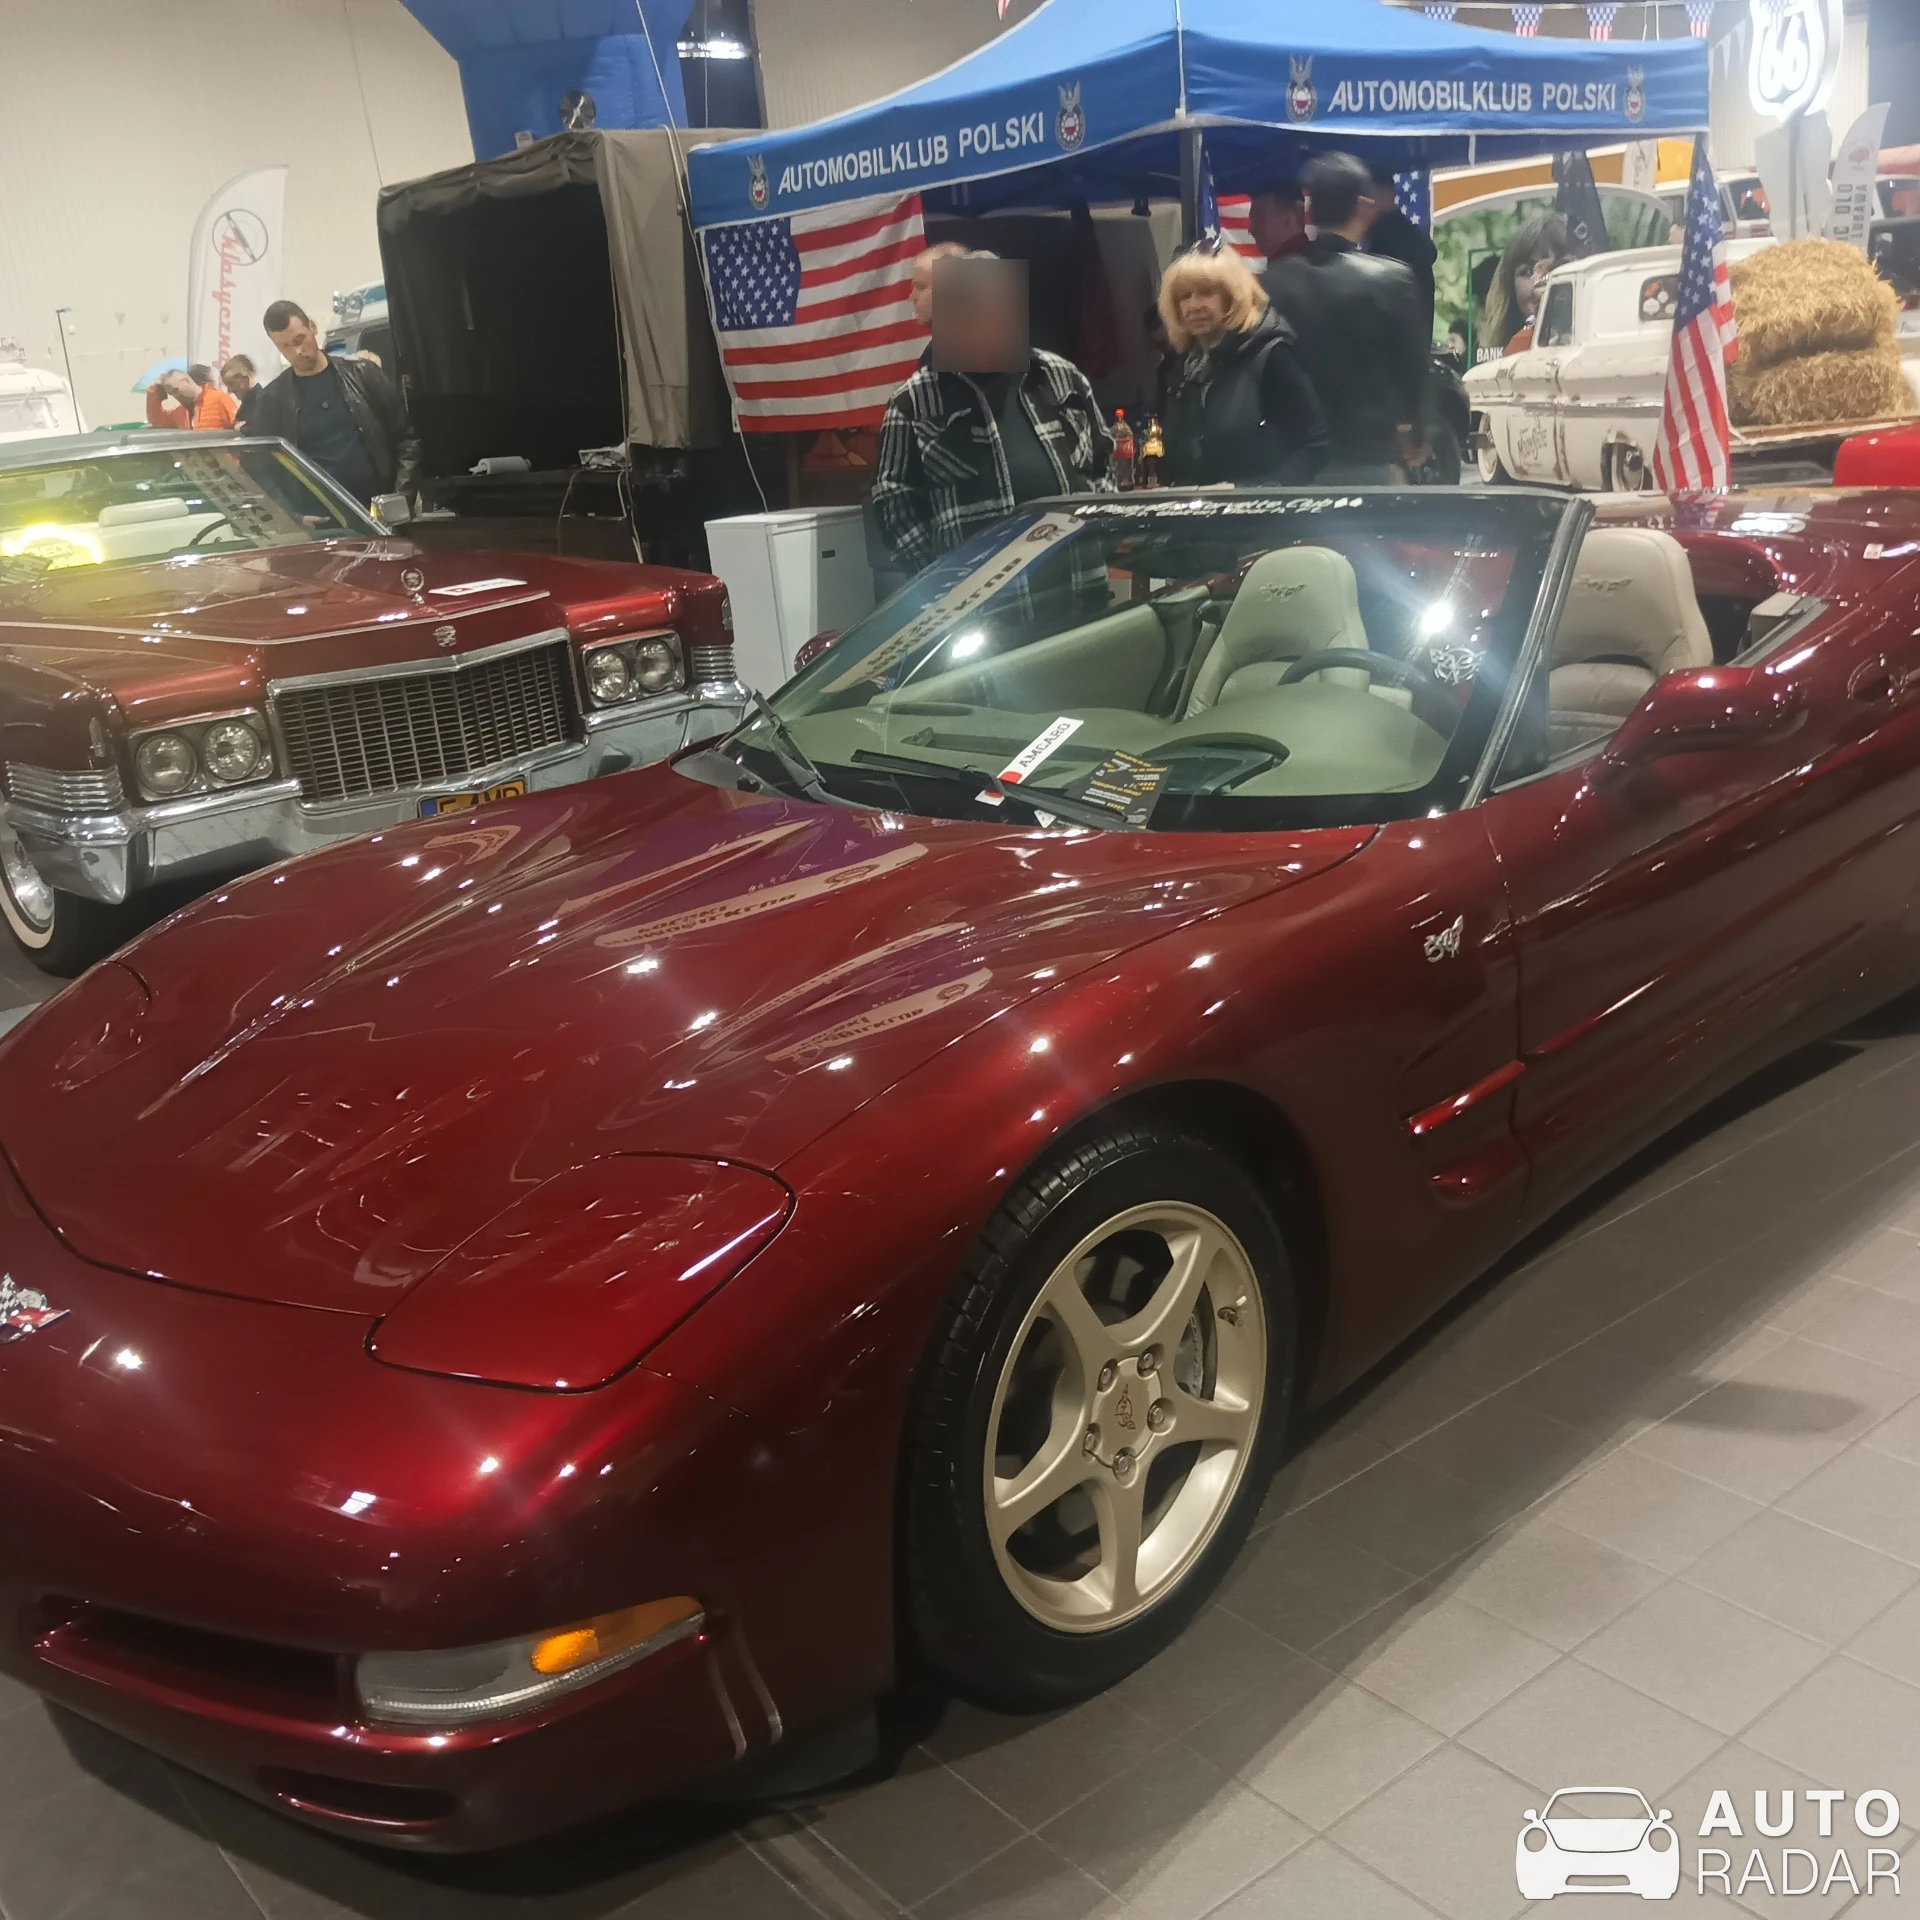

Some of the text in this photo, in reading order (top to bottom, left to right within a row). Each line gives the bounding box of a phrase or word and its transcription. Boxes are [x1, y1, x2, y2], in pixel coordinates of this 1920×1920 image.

[1327, 80, 1616, 113] AUTOMOBILKLUB POLSKI
[777, 111, 1045, 196] AUTOMOBILKLUB POLSKI
[1476, 346, 1504, 363] BANK
